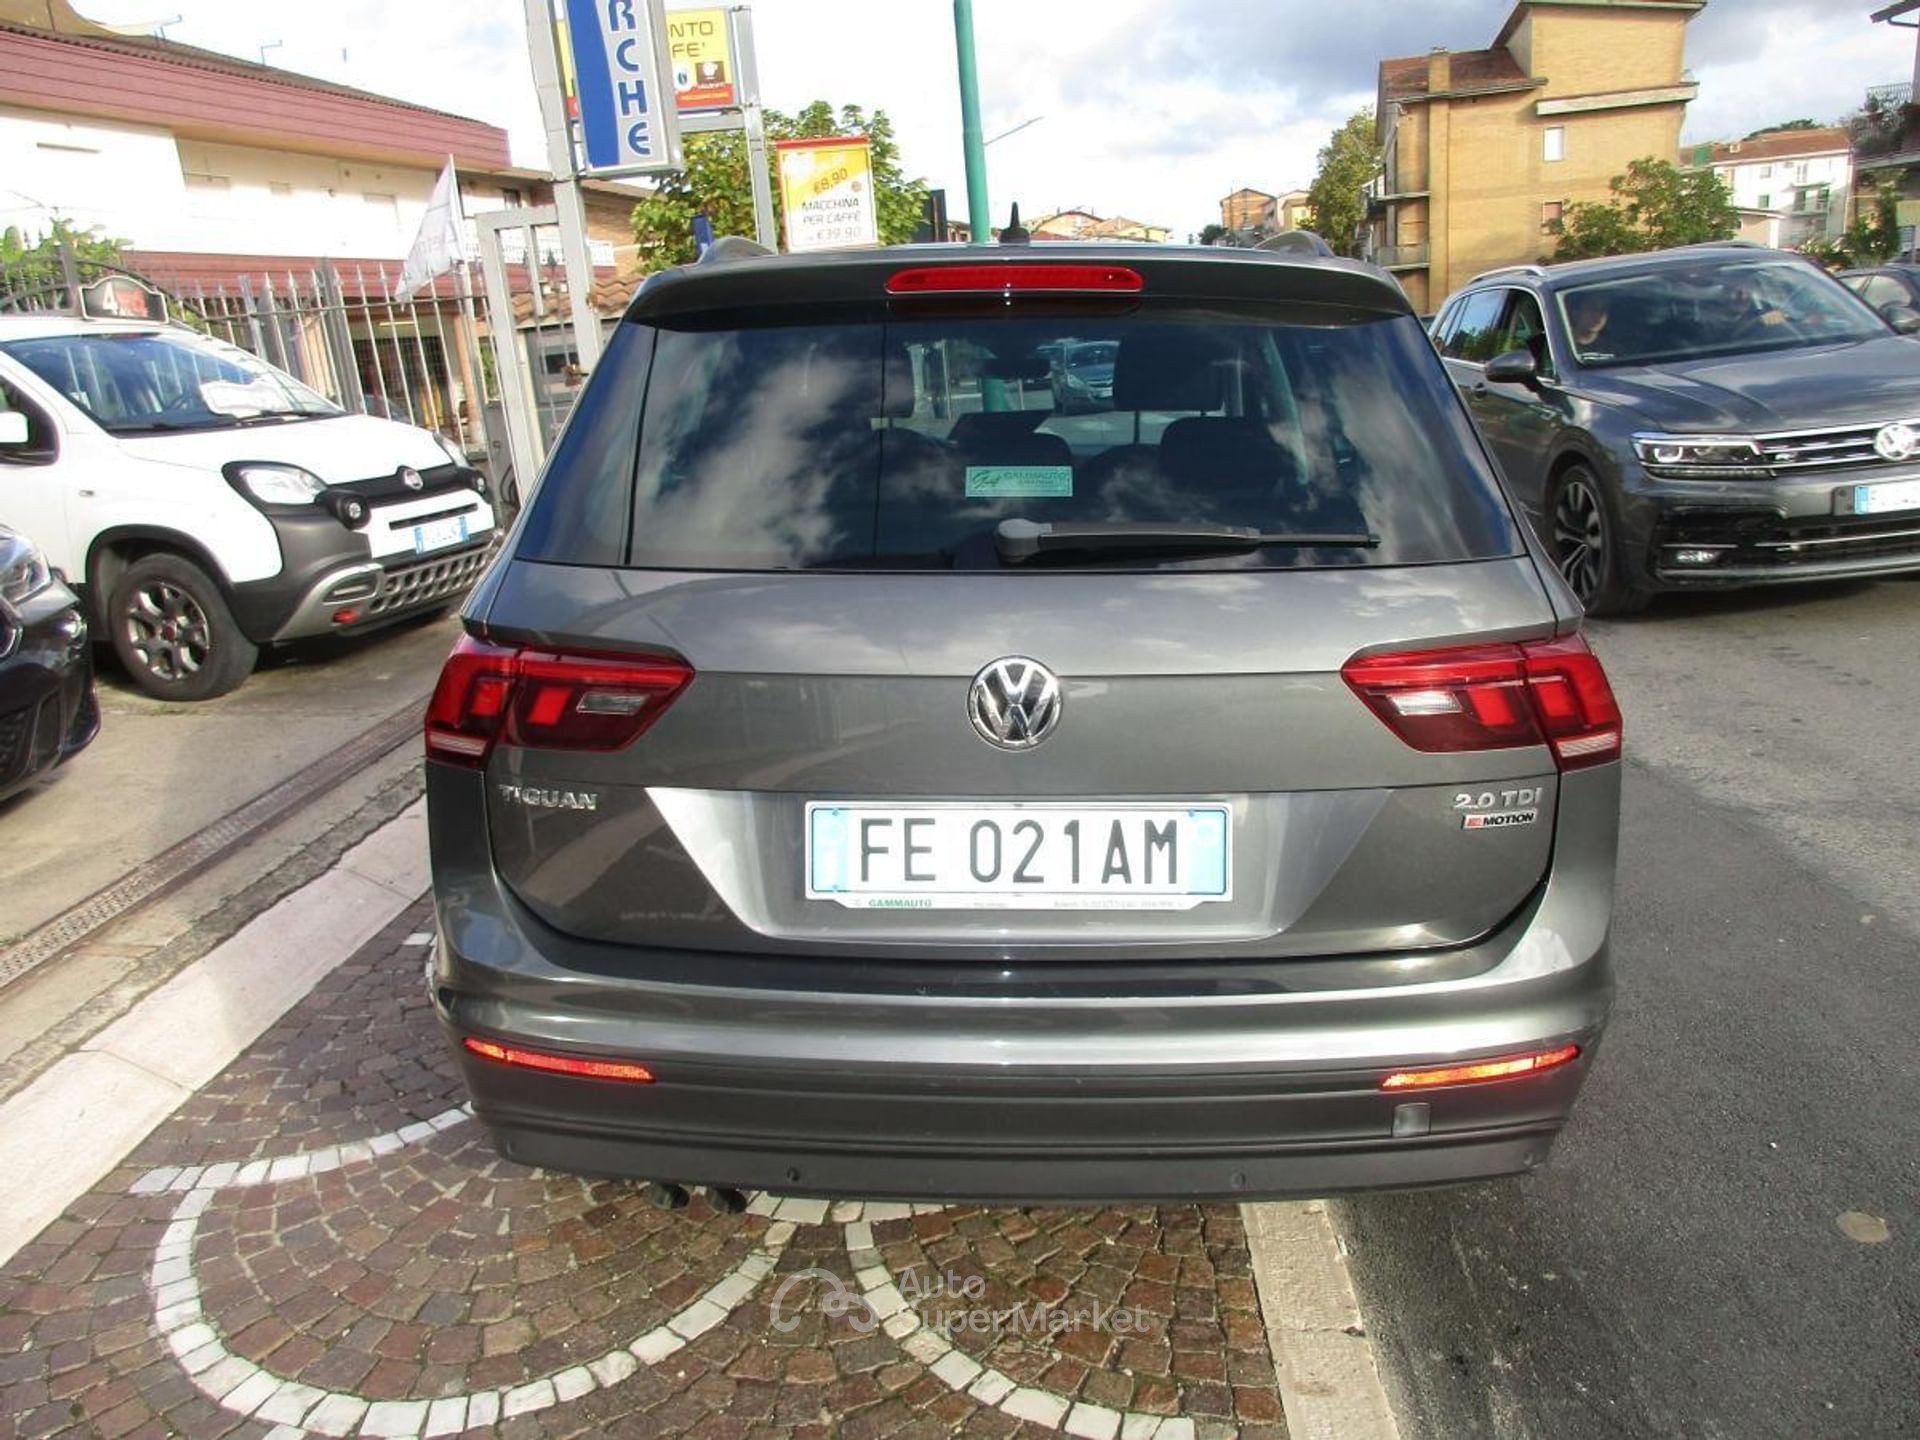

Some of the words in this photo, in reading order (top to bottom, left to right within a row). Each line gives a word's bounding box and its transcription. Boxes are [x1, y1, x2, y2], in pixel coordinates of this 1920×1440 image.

[802, 198, 859, 211] MACCHINA
[499, 784, 598, 810] TIGUAN
[1500, 787, 1543, 807] TDI
[860, 818, 936, 882] FE
[868, 898, 932, 907] GAMMAUTO
